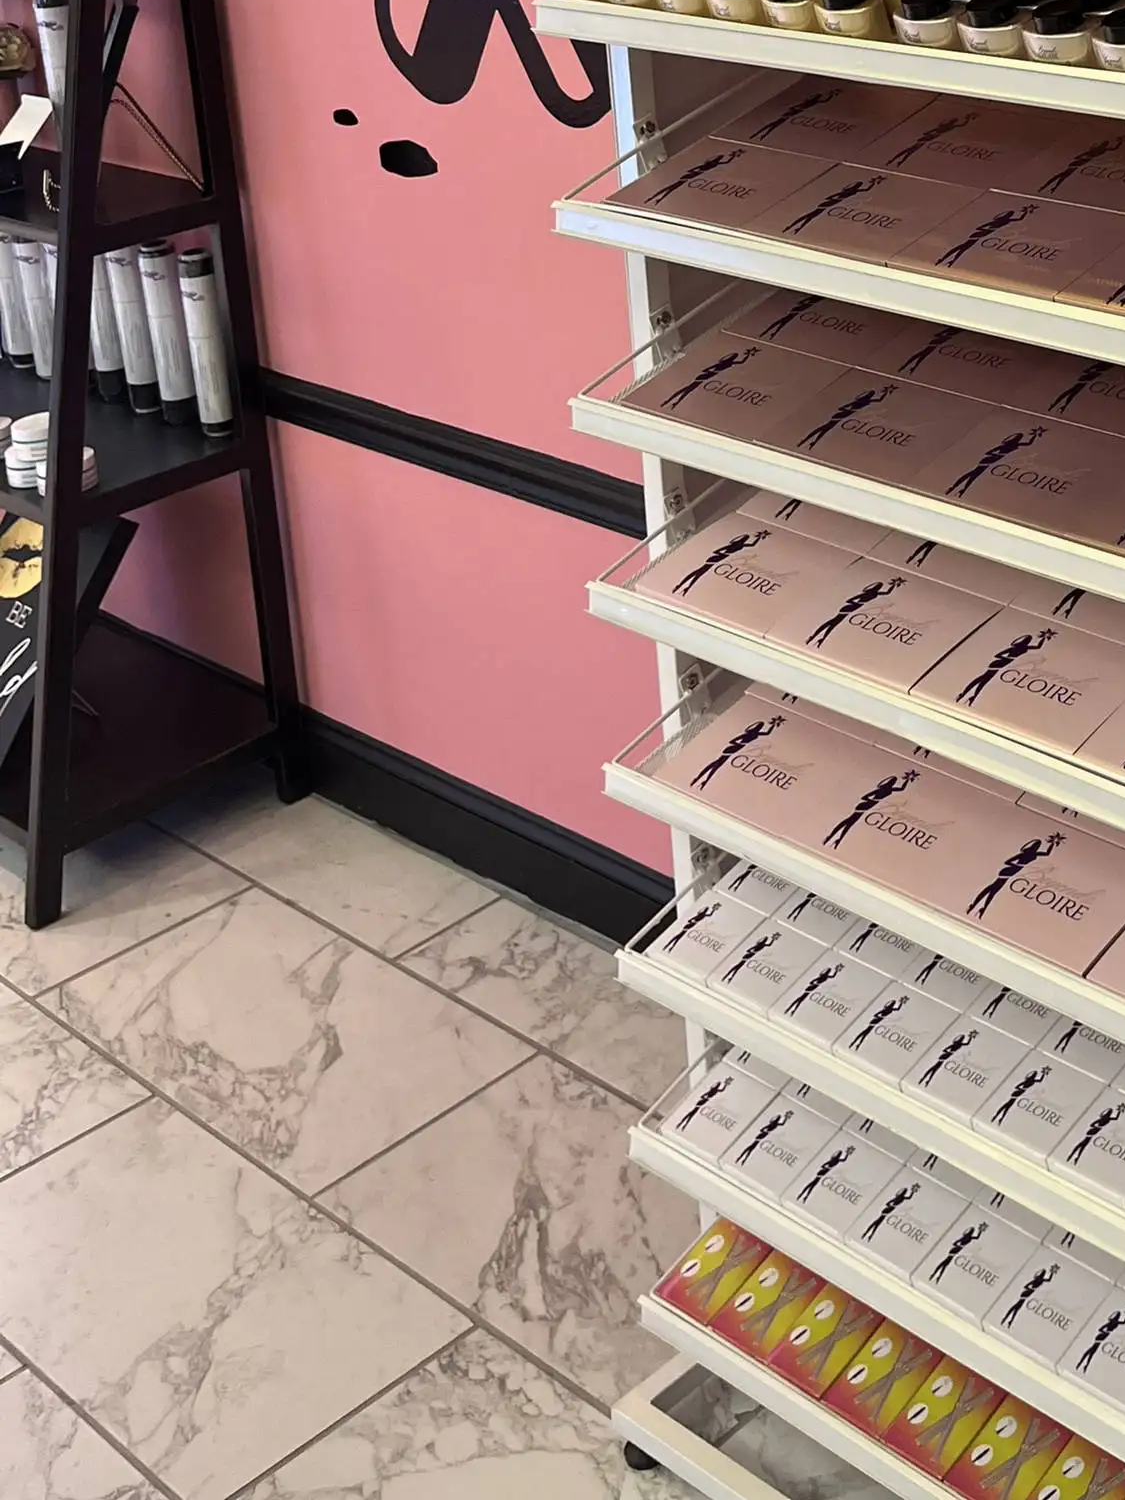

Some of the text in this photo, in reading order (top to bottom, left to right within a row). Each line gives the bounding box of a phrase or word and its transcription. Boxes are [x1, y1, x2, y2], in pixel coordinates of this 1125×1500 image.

[789, 115, 855, 135] GLOIRE
[926, 140, 998, 161] GLOIRE
[687, 178, 756, 200] GLOIRE
[827, 206, 903, 229] GLOIRE
[981, 236, 1065, 262] GLOIRE
[799, 311, 868, 335] GLOIRE
[938, 344, 1013, 368] GLOIRE
[703, 379, 773, 406] GLOIRE
[841, 418, 916, 448] GLOIRE
[990, 462, 1074, 495] GLOIRE
[714, 563, 782, 597] GLOIRE
[6, 600, 33, 629] BE
[848, 612, 923, 646] GLOIRE
[1000, 668, 1082, 707] GLOIRE
[730, 754, 798, 790] GLOIRE
[864, 811, 938, 850] GLOIRE
[751, 867, 791, 892] GLOIRE
[811, 897, 850, 922] GLOIRE
[1009, 878, 1089, 921] GLOIRE
[687, 930, 726, 953] GLOIRE
[873, 928, 916, 953] GLOIRE
[745, 959, 785, 985] GLOIRE
[939, 959, 981, 985] GLOIRE
[809, 991, 851, 1017] GLOIRE
[1007, 990, 1052, 1018] GLOIRE
[874, 1024, 918, 1053] GLOIRE
[1079, 1025, 1125, 1053] GLOIRE
[943, 1059, 988, 1089] GLOIRE
[700, 1106, 738, 1133] GLOIRE
[1016, 1097, 1065, 1127] GLOIRE
[759, 1139, 800, 1168] GLOIRE
[820, 1176, 864, 1206] GLOIRE
[886, 1214, 930, 1244] GLOIRE
[954, 1255, 1000, 1287] GLOIRE
[1026, 1298, 1074, 1331] GLOIRE
